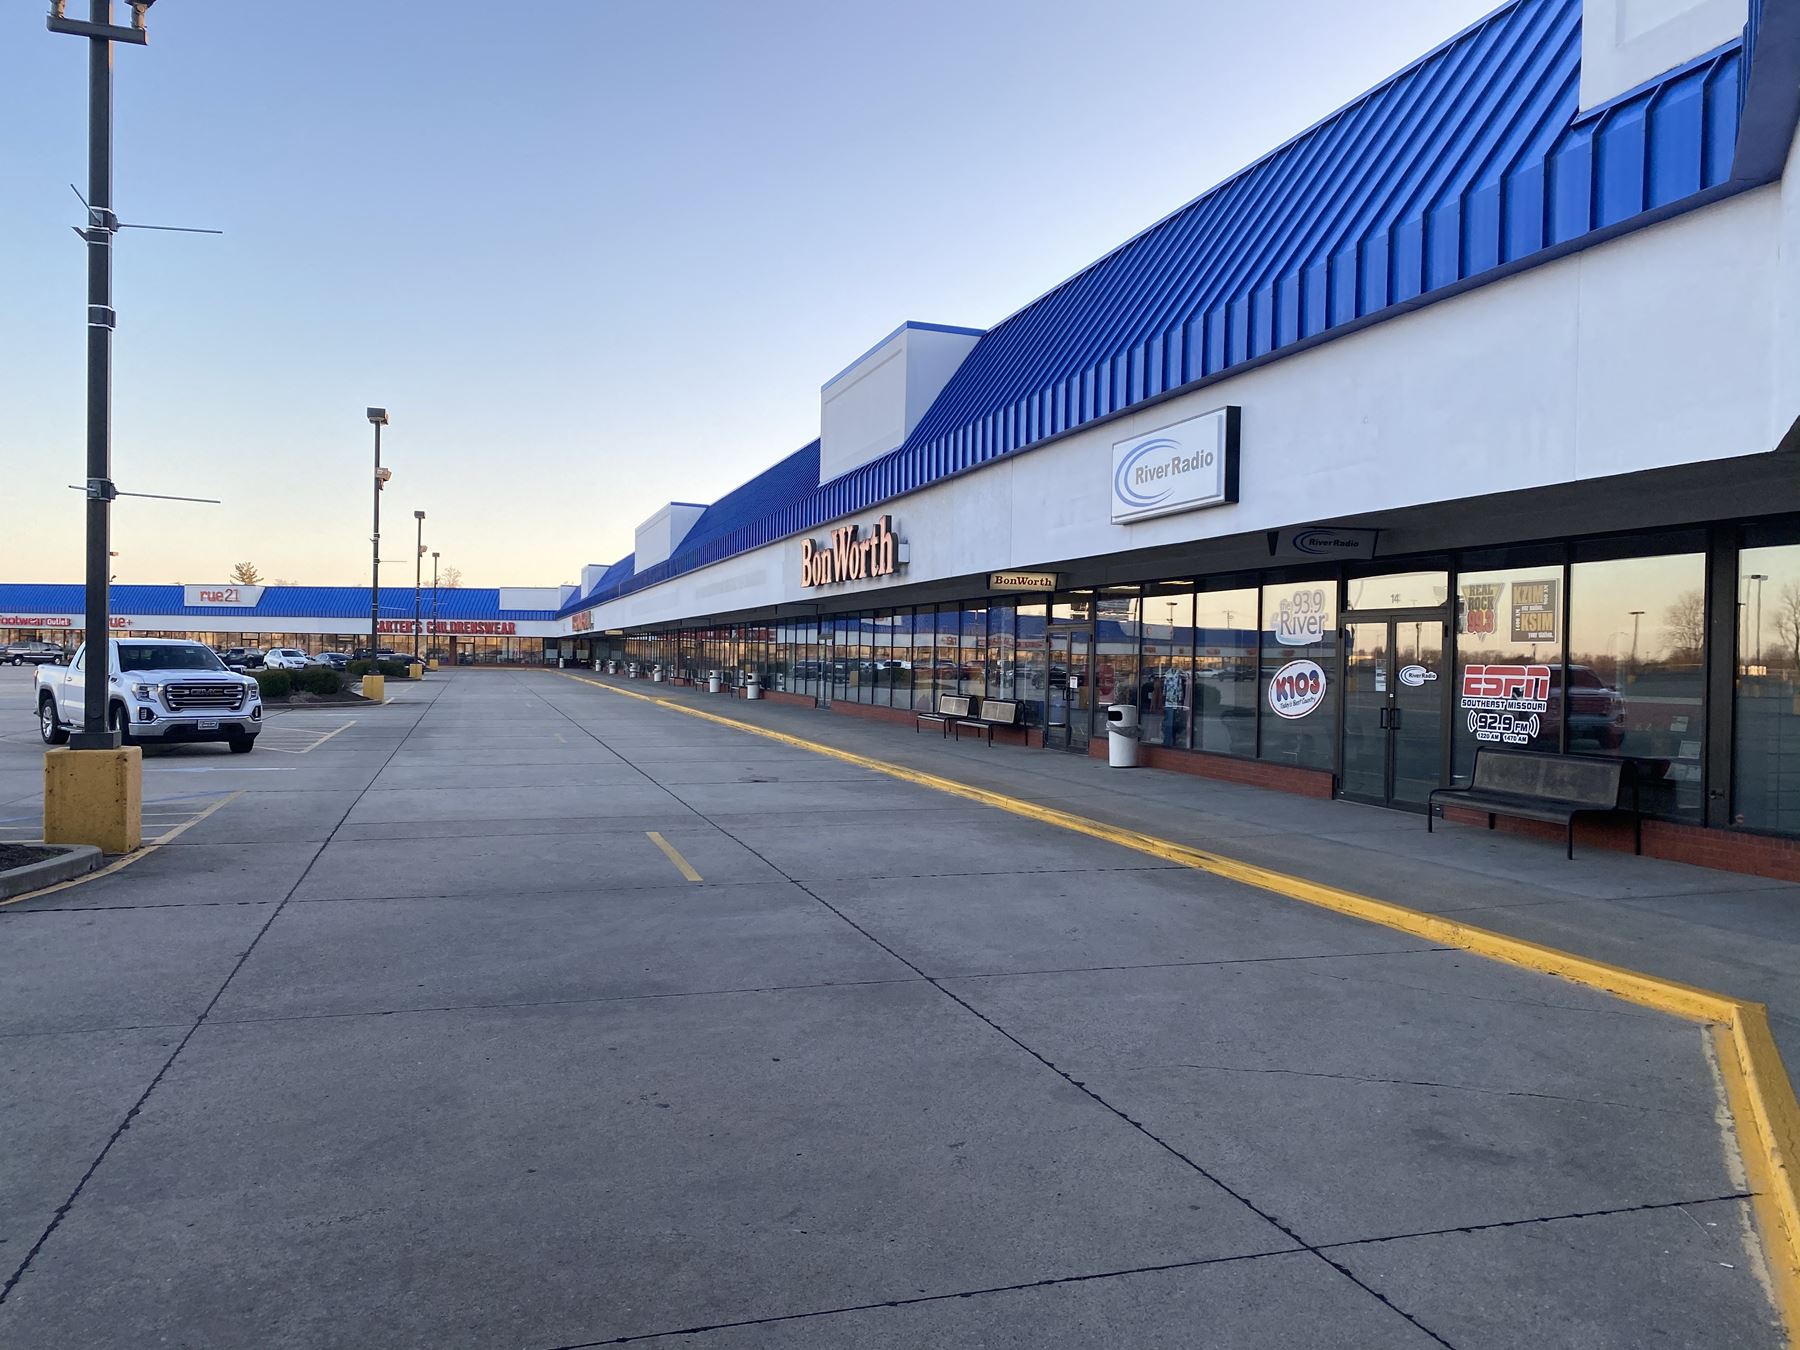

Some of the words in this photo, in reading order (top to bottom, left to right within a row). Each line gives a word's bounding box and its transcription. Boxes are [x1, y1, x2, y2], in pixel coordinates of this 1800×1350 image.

[801, 515, 896, 588] BonWorth
[994, 575, 1052, 587] BonWorth
[1469, 584, 1494, 596] REAL
[200, 588, 240, 602] rue21
[1293, 591, 1323, 614] 93.9
[1468, 596, 1494, 610] ROCK
[1513, 585, 1544, 605] KZIM
[0, 615, 44, 626] ootwear
[1280, 611, 1326, 635] River
[1467, 609, 1494, 633] 99.3
[1521, 612, 1553, 631] KSIM
[1276, 670, 1320, 702] K103
[1463, 665, 1550, 700] ESPN
[1462, 699, 1506, 709] SOUTHEAST
[1507, 700, 1546, 711] MISSOURI
[1478, 714, 1514, 732] 92.9
[1515, 722, 1529, 733] FM
